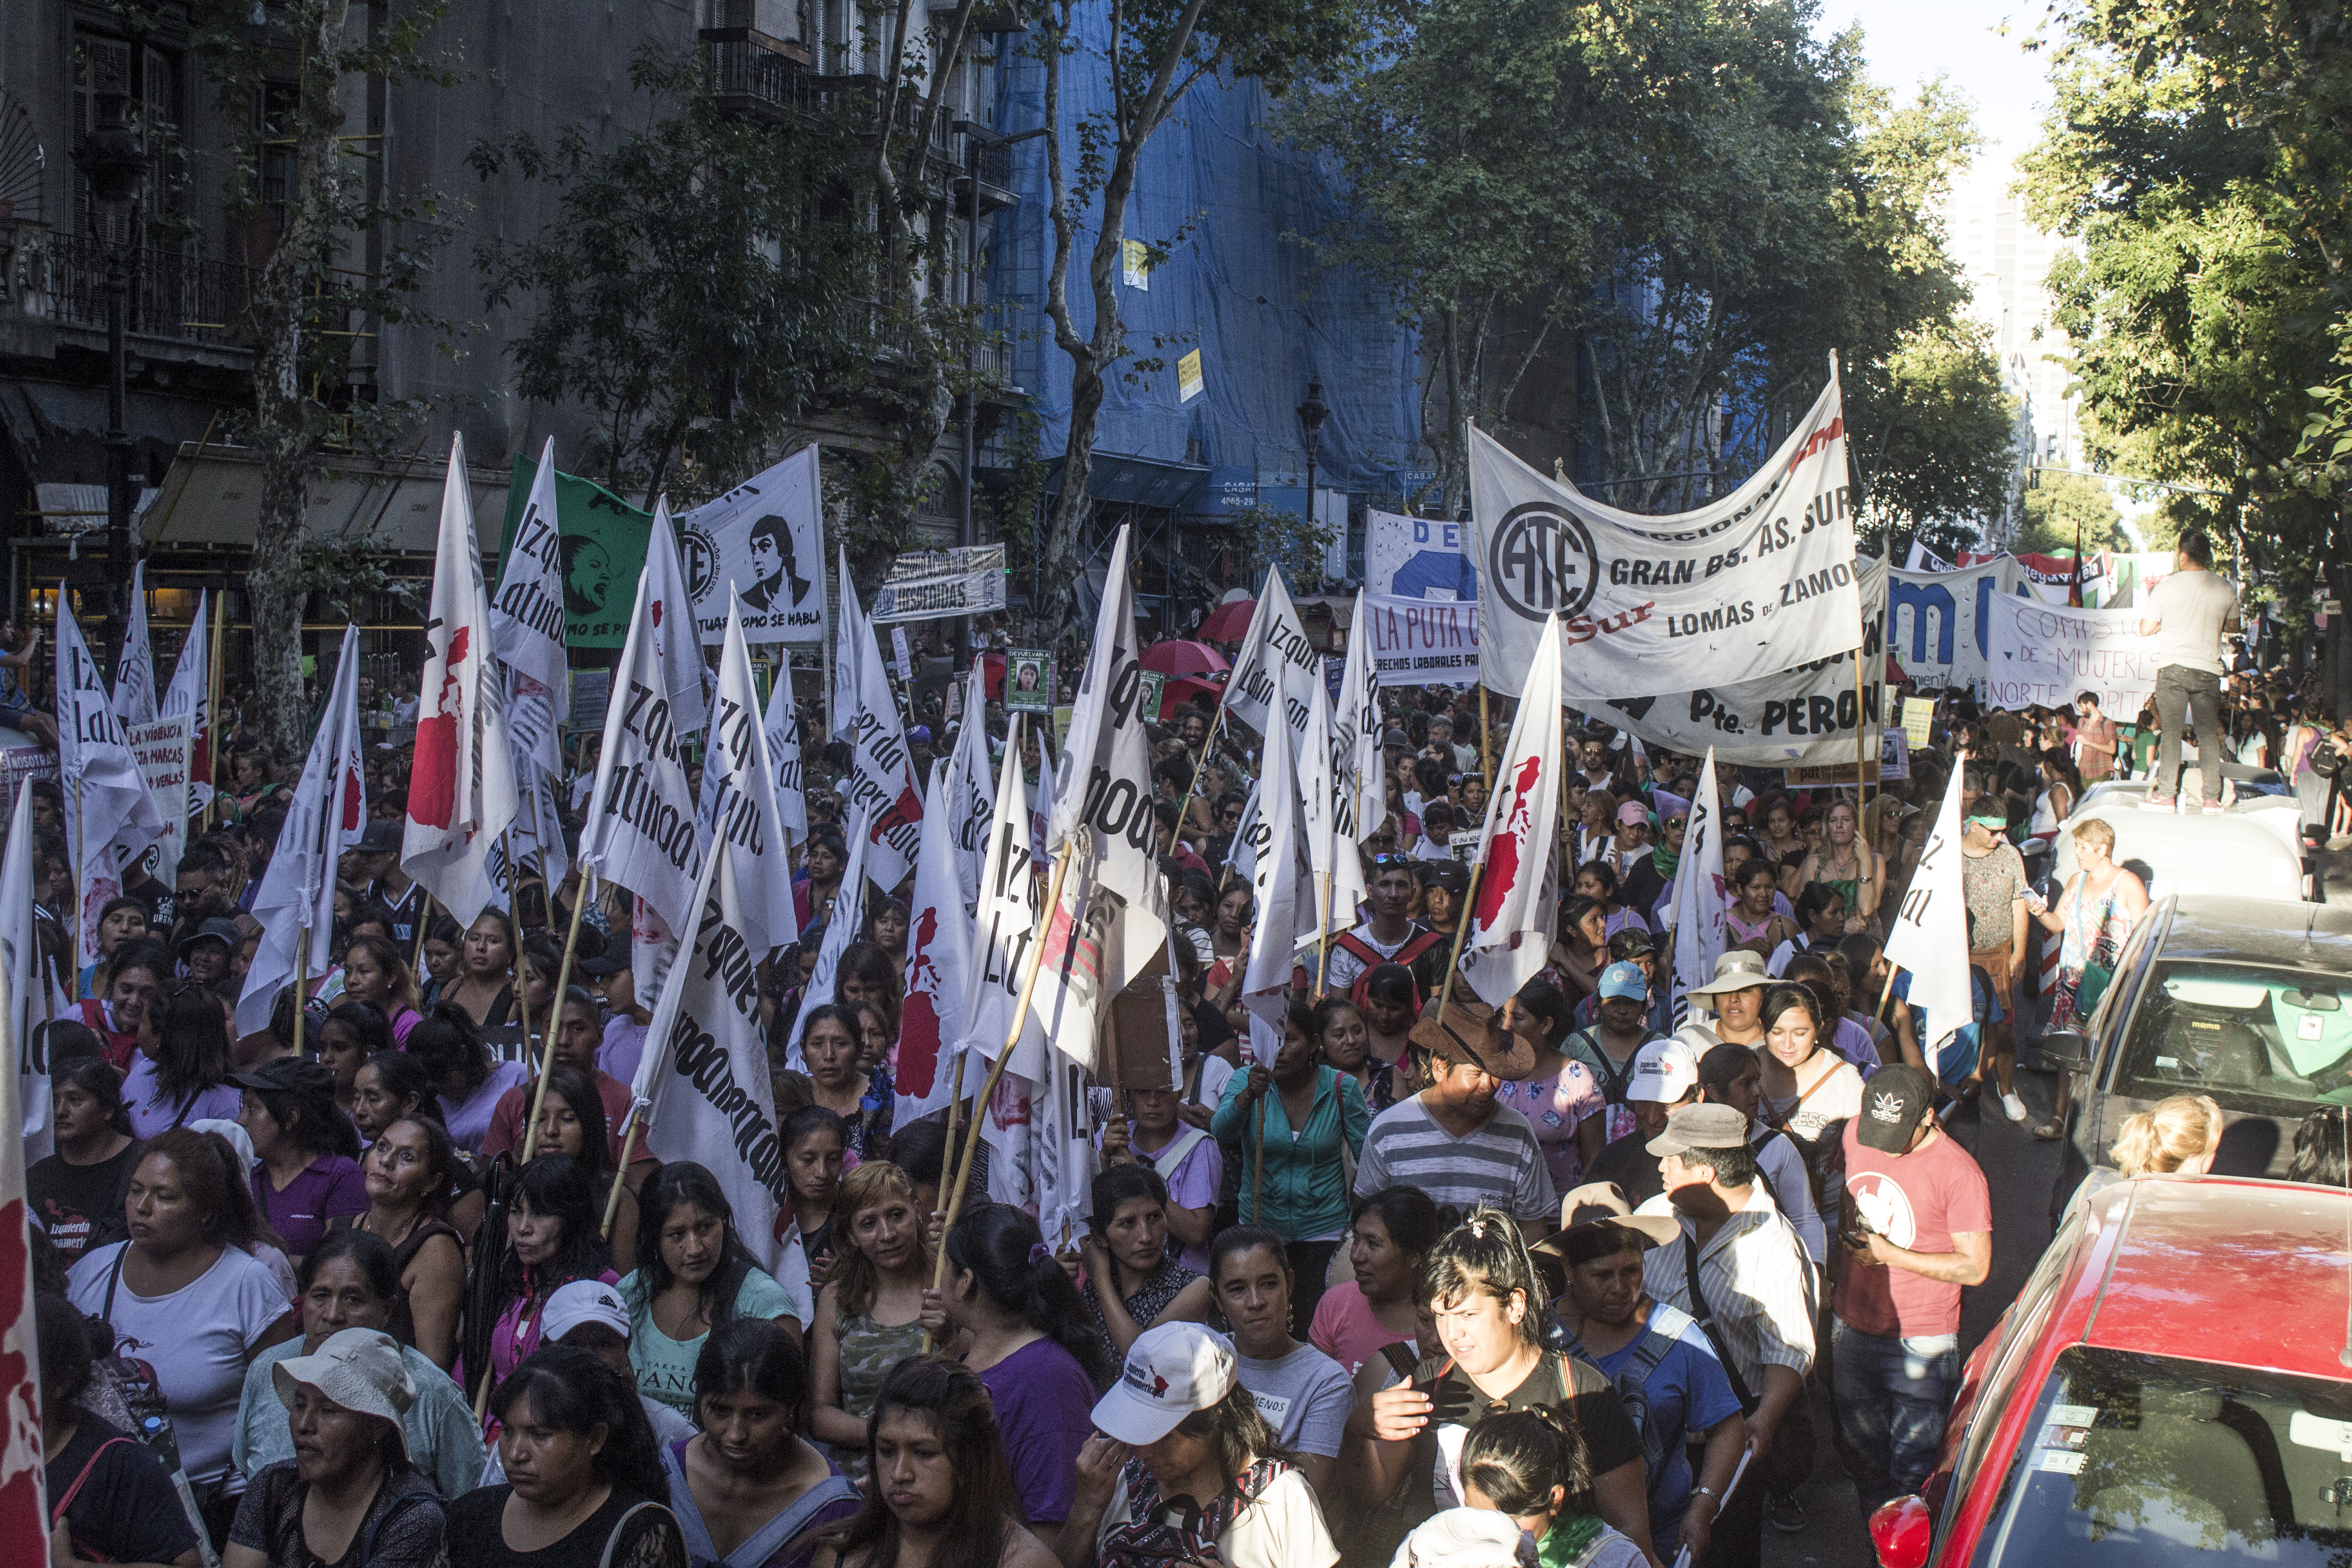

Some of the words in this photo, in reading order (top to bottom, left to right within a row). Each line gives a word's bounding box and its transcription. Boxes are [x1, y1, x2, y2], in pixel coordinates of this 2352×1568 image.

[1610, 558, 1695, 586] GRAN
[1758, 516, 1797, 552] AS.
[1503, 516, 1577, 609] ATE
[489, 579, 566, 652] atino
[741, 616, 768, 628] OMO
[770, 611, 785, 627] SE
[788, 610, 821, 627] HABLA
[1567, 601, 1656, 646] Sur
[1667, 599, 1754, 638] LOMAS
[2016, 607, 2161, 639] COMISIO
[592, 622, 609, 636] SE
[613, 622, 630, 635] PI
[1374, 607, 1400, 651] LA
[1406, 607, 1462, 650] PUTA
[1374, 657, 1411, 671] ERECHOS
[1413, 654, 1462, 670] LABORALES
[2020, 645, 2039, 663] DE
[1238, 658, 1309, 733] Latinam
[1989, 681, 2060, 706] NORTE
[1690, 690, 1744, 735] Pte.
[1762, 681, 1880, 735] PERON
[623, 680, 682, 771] zqu
[129, 731, 142, 746] LA
[11, 752, 59, 769] NOSOTRAS
[134, 751, 149, 766] EJA
[151, 747, 184, 765] MARCAS
[13, 767, 59, 782] MAHAMO
[156, 770, 185, 789] VERLAS
[996, 822, 1039, 911] Iz
[1871, 1109, 1902, 1123] adidas
[50, 1221, 90, 1235] Izquierda
[647, 1361, 676, 1370] TAKE
[1127, 1360, 1147, 1380] Izquierda
[1123, 1370, 1166, 1399] Latinoamericana
